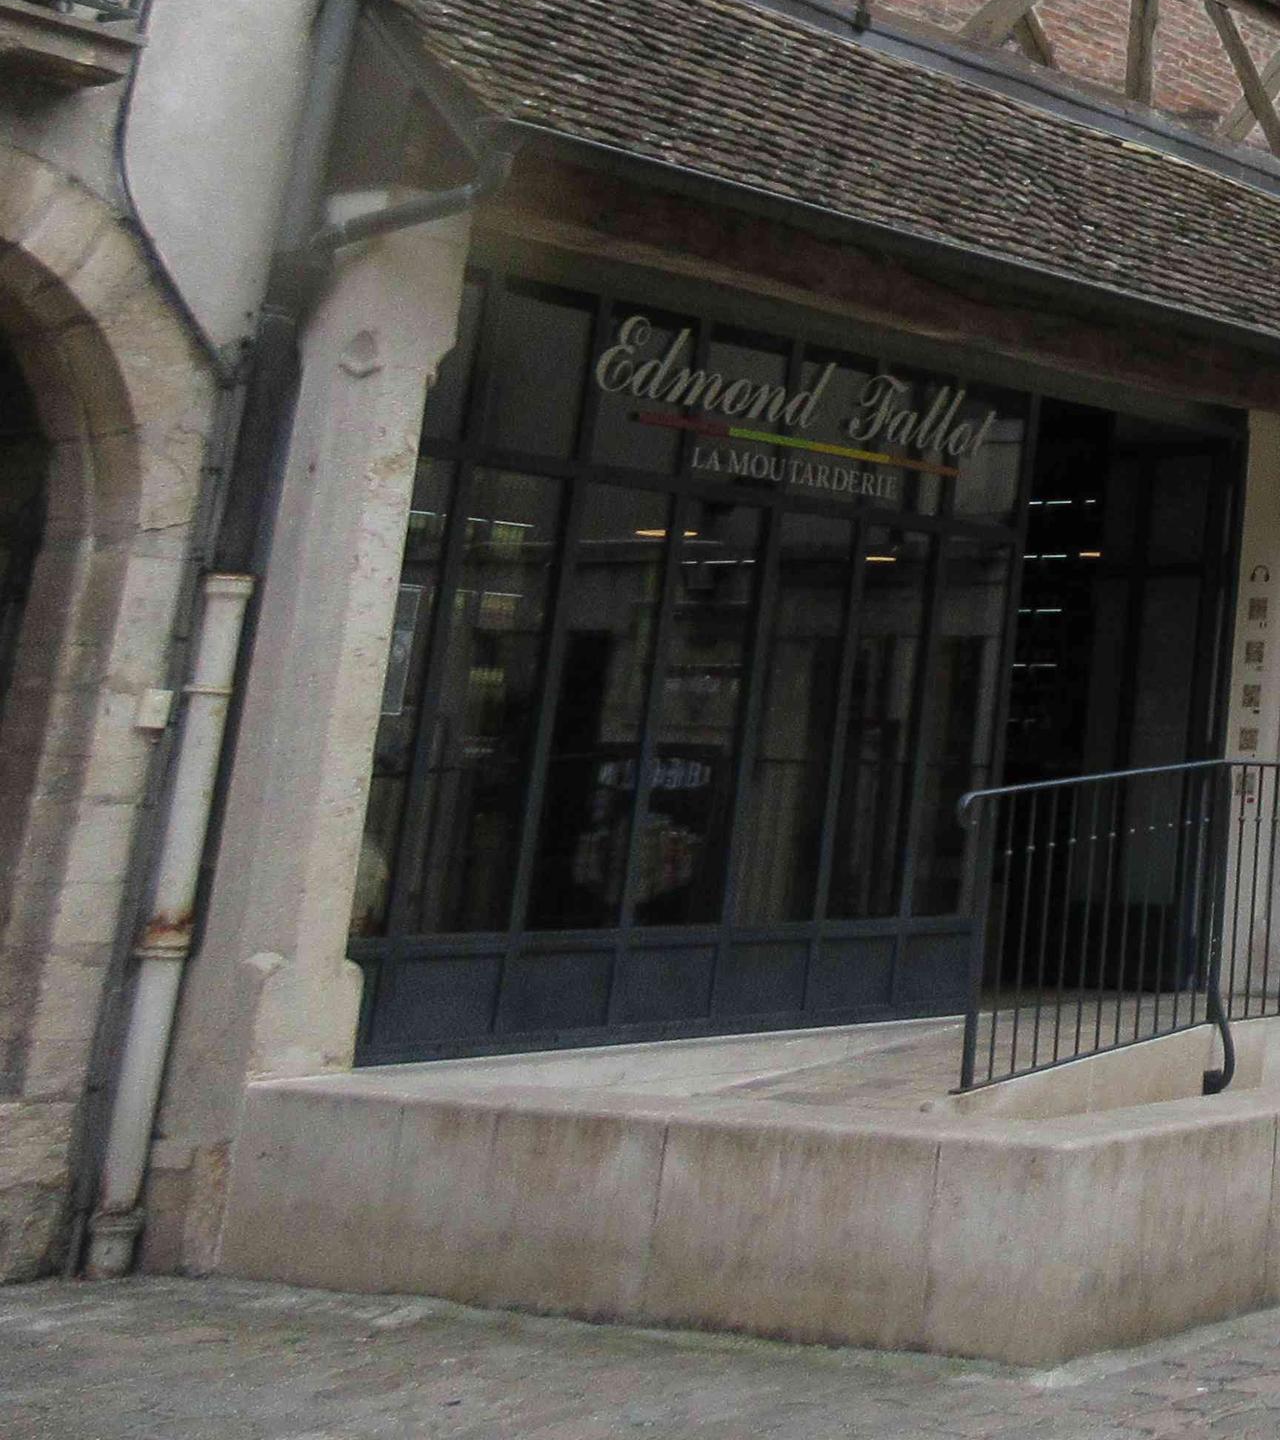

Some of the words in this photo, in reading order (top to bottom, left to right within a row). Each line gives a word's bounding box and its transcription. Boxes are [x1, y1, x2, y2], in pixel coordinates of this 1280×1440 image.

[595, 315, 837, 429] Edmond
[848, 374, 998, 458] Fallot
[691, 446, 722, 473] LA
[727, 453, 899, 498] MOUTARDERIE
